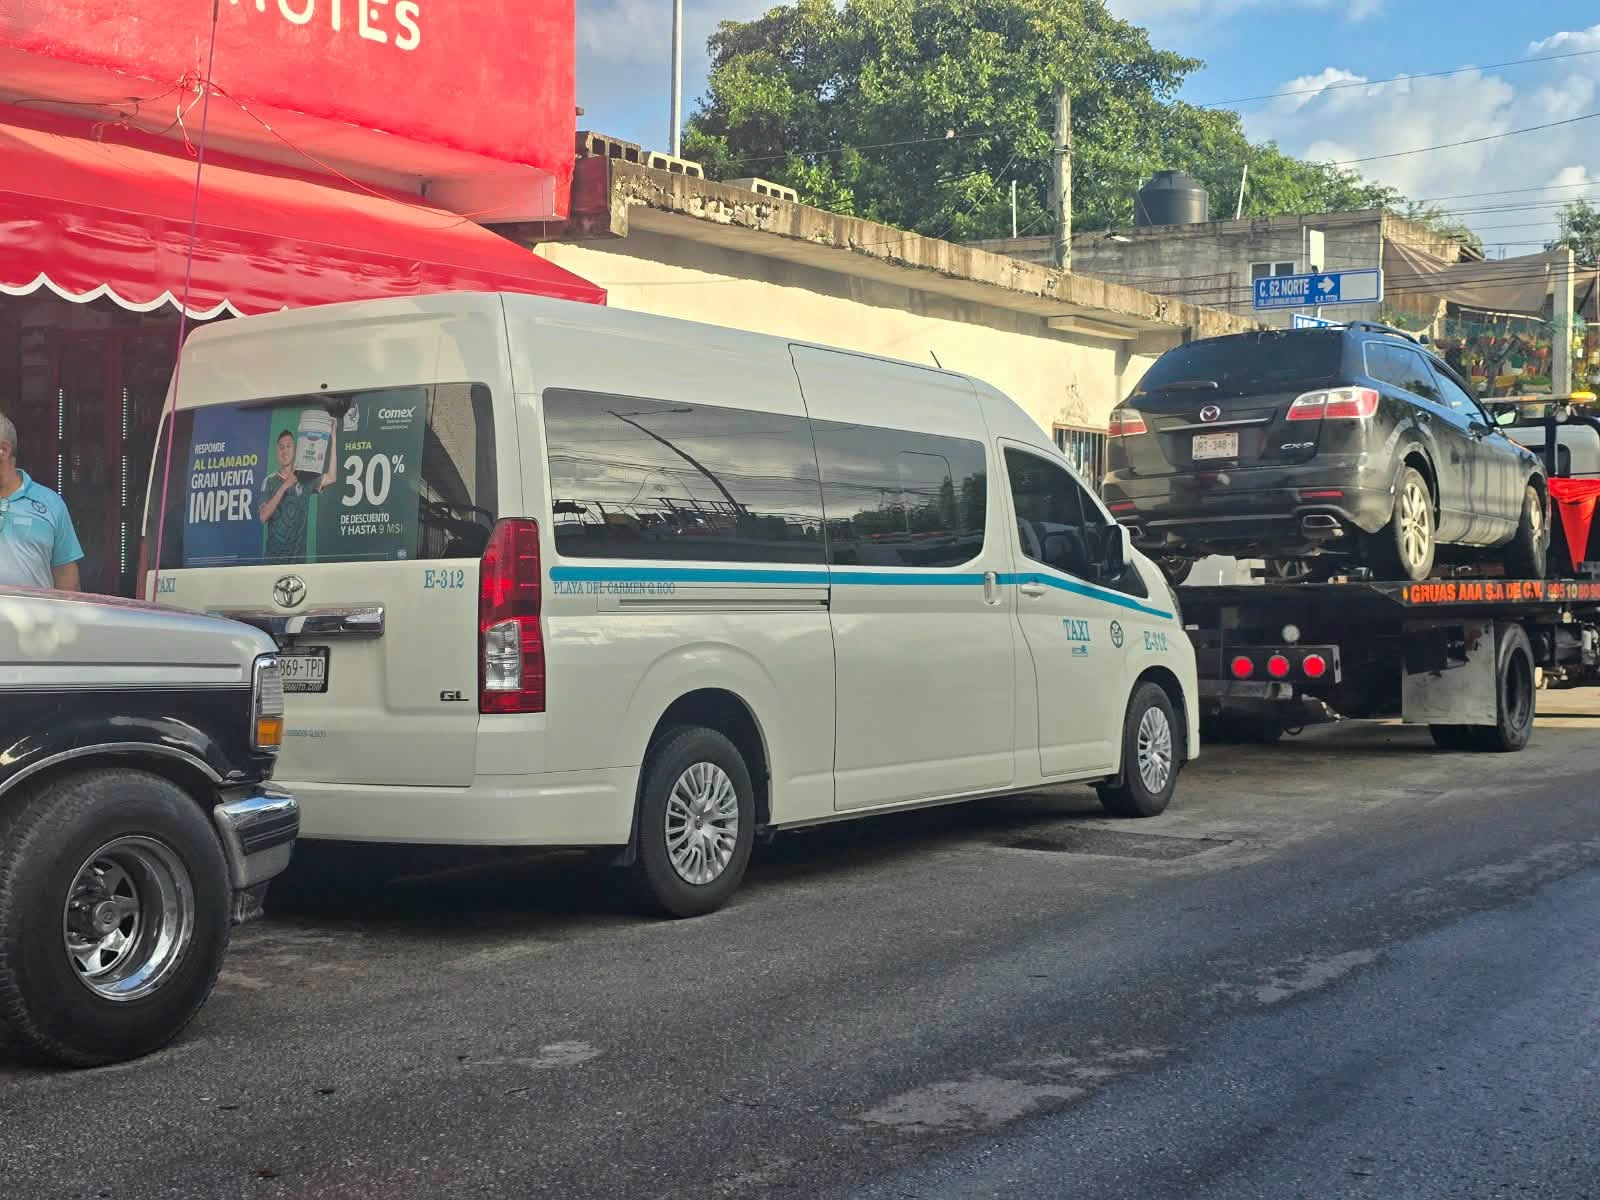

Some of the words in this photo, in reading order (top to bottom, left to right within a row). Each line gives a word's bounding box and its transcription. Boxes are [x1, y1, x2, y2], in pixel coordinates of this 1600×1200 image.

[1260, 281, 1268, 297] C.
[1269, 280, 1280, 296] 62
[1281, 278, 1310, 295] NORTE
[378, 405, 416, 419] Comex
[194, 441, 226, 455] RESPONDE
[344, 441, 373, 451] HASTA
[193, 457, 205, 471] AL
[207, 454, 258, 470] LLAMADO
[191, 473, 219, 489] GRAN
[220, 469, 254, 487] VENTA
[341, 453, 405, 507] 30%
[189, 488, 252, 523] IMPER
[340, 514, 350, 524] DE
[350, 512, 390, 524] DESCUENTO
[340, 525, 347, 536] Y
[347, 524, 377, 535] HASTA
[423, 569, 465, 589] E-312
[553, 581, 584, 594] PLAYA
[586, 581, 605, 594] DEL
[607, 581, 646, 595] CARMEN
[1410, 583, 1456, 603] GRUAS
[1459, 583, 1482, 601] AAA
[1506, 582, 1521, 600] DE
[1566, 583, 1578, 599] 10
[1062, 619, 1091, 641] TAXI
[440, 690, 469, 702] GL
